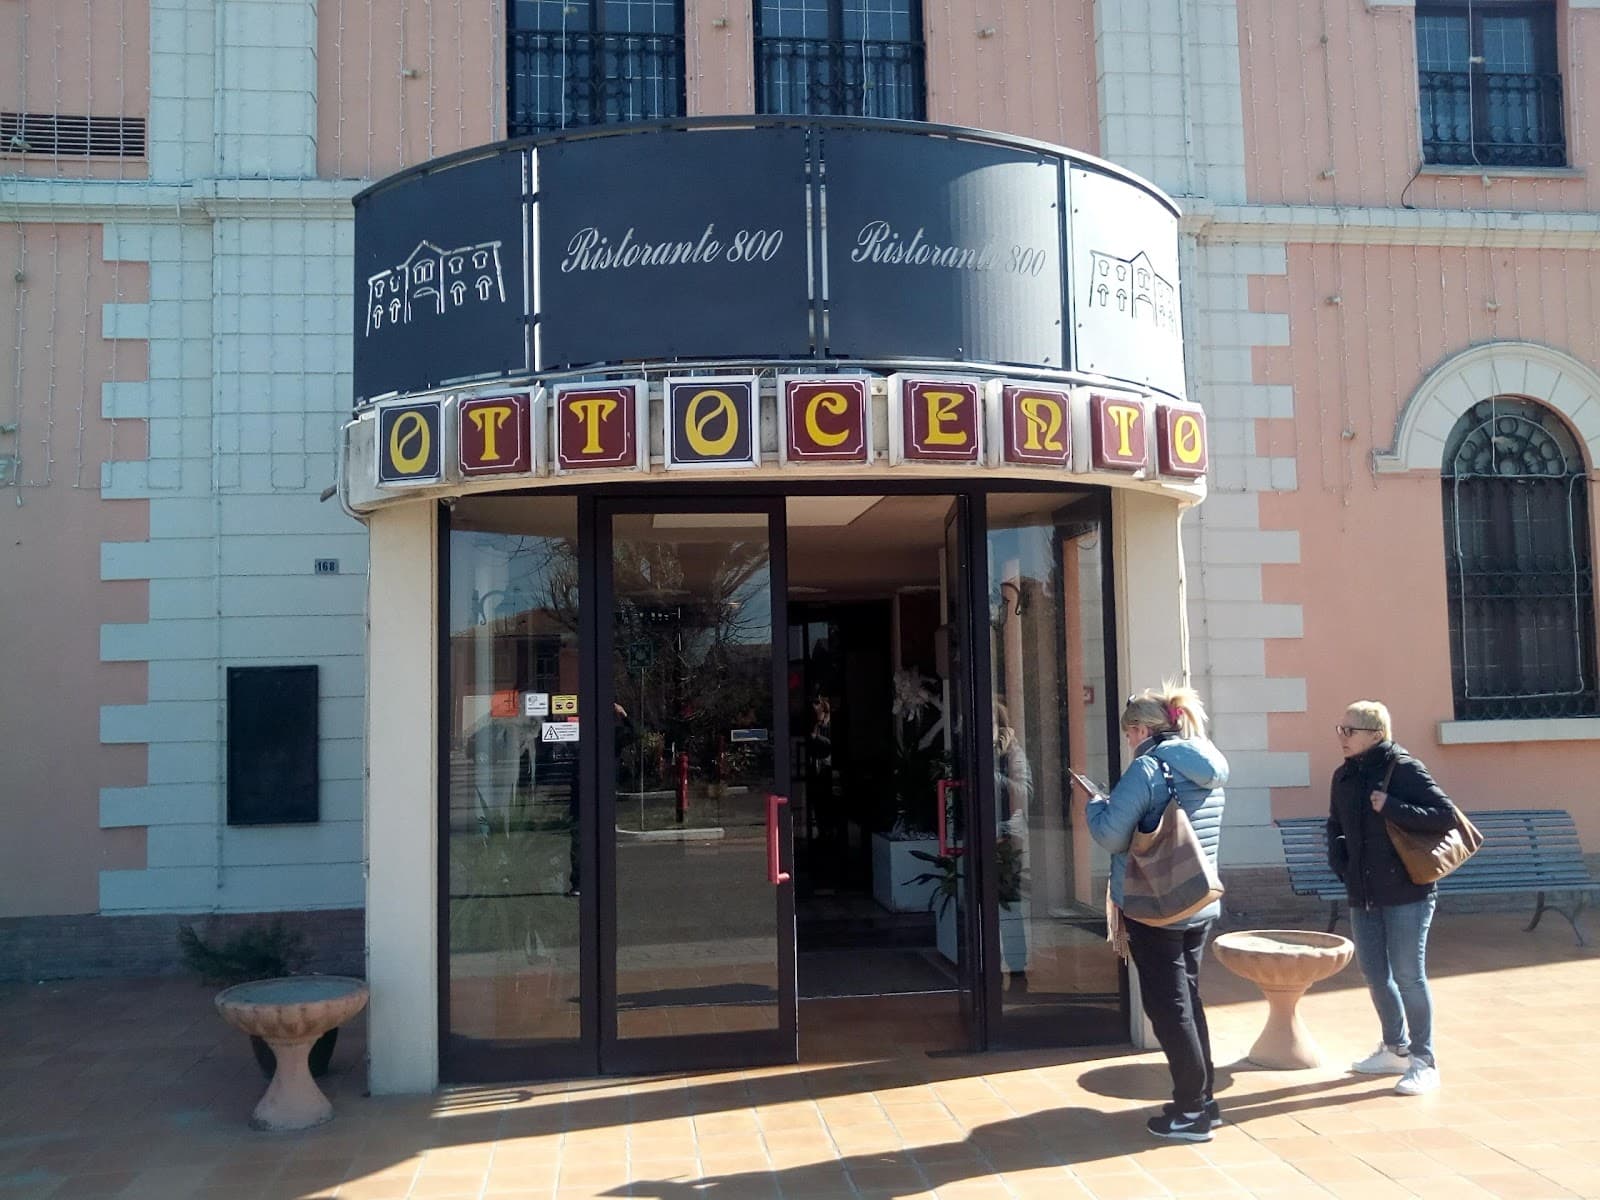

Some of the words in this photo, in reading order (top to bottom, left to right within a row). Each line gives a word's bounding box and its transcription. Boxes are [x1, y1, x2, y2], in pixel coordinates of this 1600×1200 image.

[561, 223, 723, 273] Ristorante
[726, 229, 784, 262] 800
[1004, 244, 1046, 278] 800
[389, 389, 1202, 474] OTTOCENTO
[318, 561, 335, 572] 168
